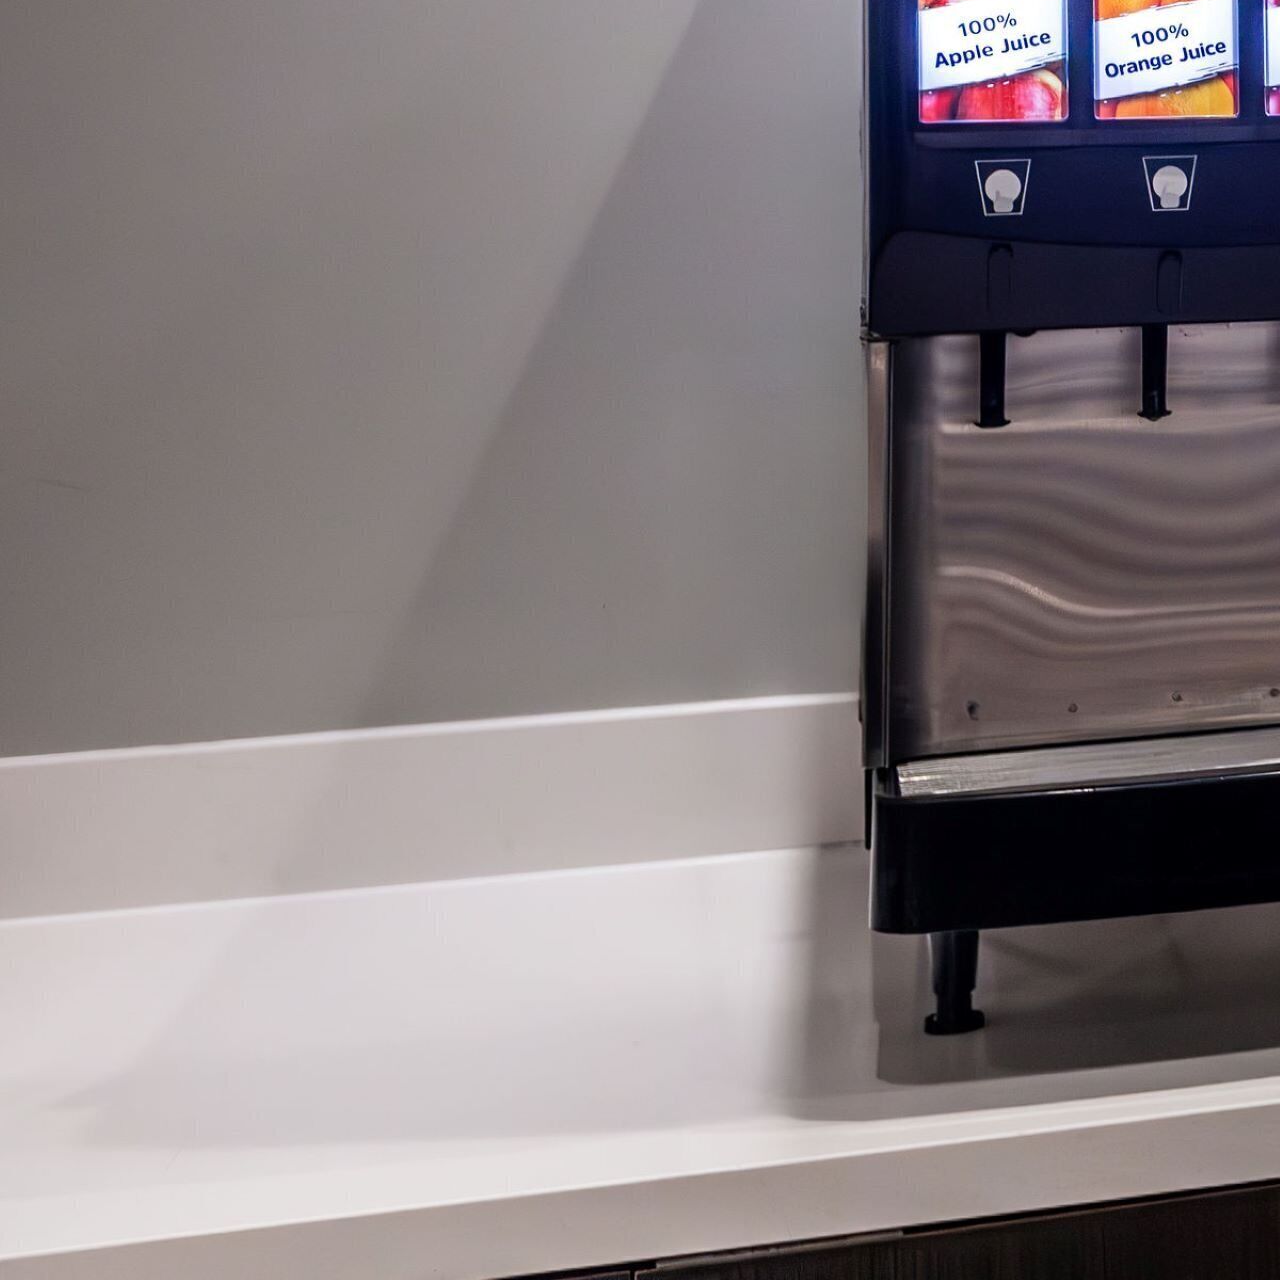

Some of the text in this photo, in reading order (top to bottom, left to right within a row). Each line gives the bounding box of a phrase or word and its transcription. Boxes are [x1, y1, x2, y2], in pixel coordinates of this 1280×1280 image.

[958, 12, 1018, 37] 100%
[1131, 23, 1190, 48] 100%
[934, 32, 1052, 69] Apple Juice
[1104, 41, 1227, 79] Orange Juice
